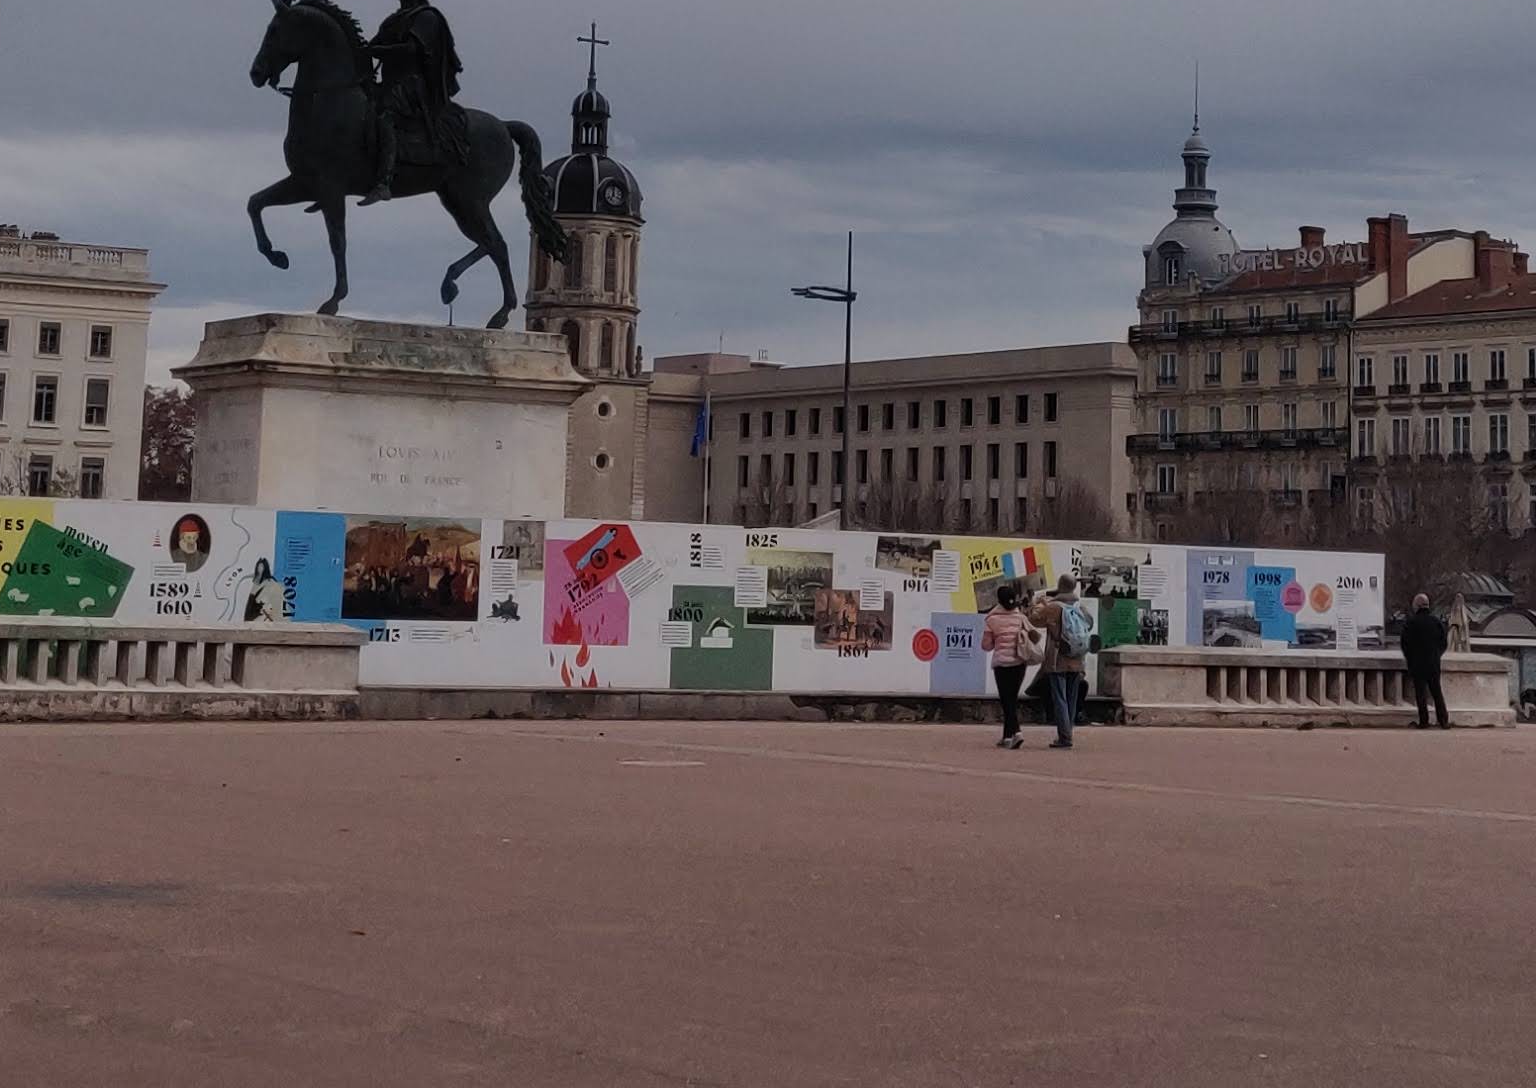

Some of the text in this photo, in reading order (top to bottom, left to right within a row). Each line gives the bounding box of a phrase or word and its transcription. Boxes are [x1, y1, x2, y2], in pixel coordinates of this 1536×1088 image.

[1294, 243, 1369, 269] ROYAL
[64, 525, 109, 554] moyen
[745, 533, 778, 548] 1825
[491, 545, 521, 560] 1721
[690, 532, 702, 569] 1818
[969, 555, 999, 575] 1944
[1202, 571, 1230, 584] 1978
[1253, 572, 1282, 586] 1998
[1336, 575, 1364, 589] 2016
[149, 582, 190, 599] 1589
[903, 579, 929, 593] 1914
[282, 575, 298, 618] 1708
[156, 599, 192, 616] 1610
[668, 607, 704, 623] 1800
[946, 634, 972, 648] 1941
